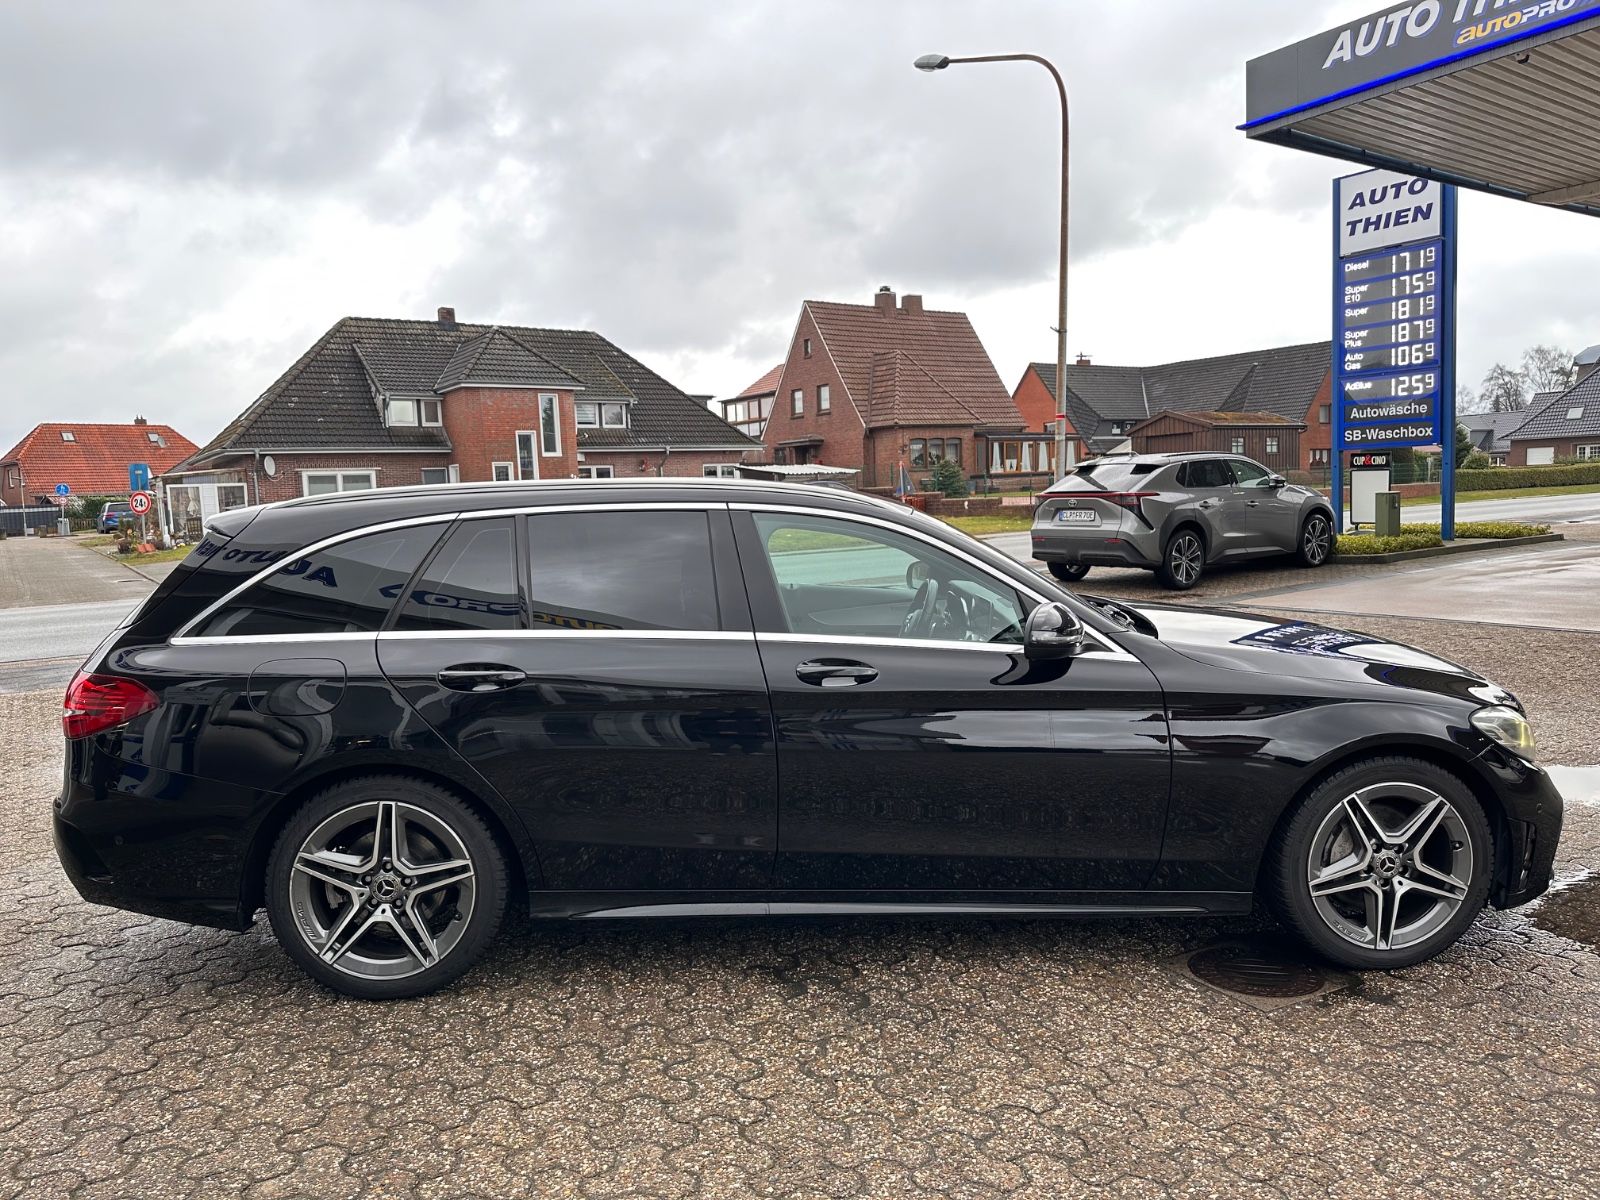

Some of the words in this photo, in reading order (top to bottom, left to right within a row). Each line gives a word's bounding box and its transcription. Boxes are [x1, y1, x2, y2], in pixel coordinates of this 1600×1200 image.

[1322, 0, 1440, 69] AUTO
[1348, 178, 1429, 210] AUTO
[1346, 202, 1434, 237] THIEN
[1344, 260, 1369, 272] Diesel
[1391, 247, 1435, 273] 1719
[1344, 284, 1369, 295] Super
[1391, 271, 1435, 297] 1759
[1344, 294, 1361, 304] E10
[1344, 307, 1369, 317] Super
[1391, 295, 1435, 320] 1819
[1344, 330, 1369, 340] Super
[1391, 318, 1435, 343] 1879
[1344, 340, 1362, 349] Plus
[1344, 353, 1364, 362] Auto
[1391, 343, 1435, 366] 1069
[1344, 362, 1361, 371] Gas
[1344, 381, 1373, 391] AdBlue
[1391, 373, 1435, 396] 1259
[1350, 402, 1428, 419] Autowäsche
[1344, 426, 1433, 442] SB-Waschbox
